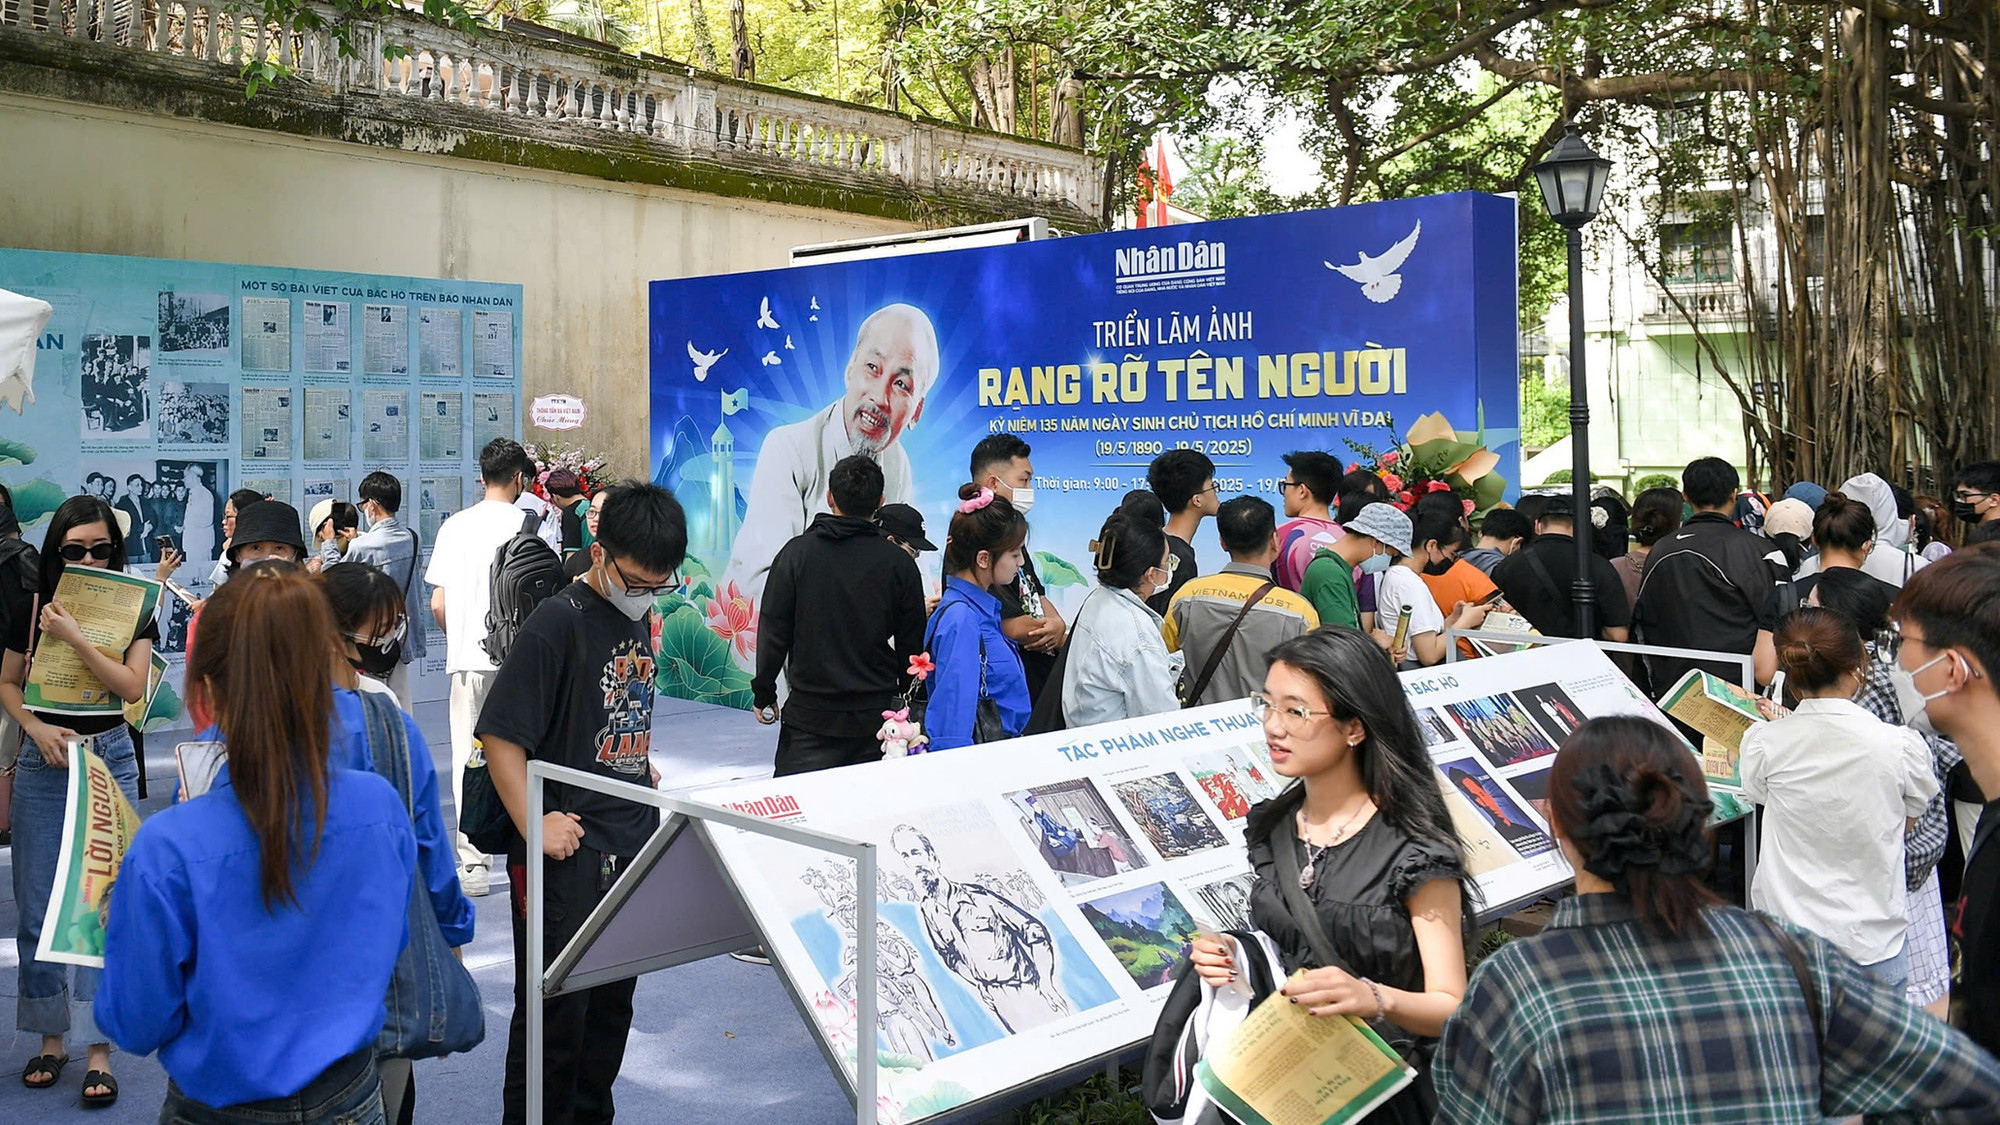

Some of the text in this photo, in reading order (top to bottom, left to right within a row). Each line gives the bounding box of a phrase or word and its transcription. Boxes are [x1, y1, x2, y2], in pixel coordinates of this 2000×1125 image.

[1115, 240, 1225, 277] Nhân Dân
[1093, 305, 1253, 348] TRIỂN LÃM ẢNH
[978, 341, 1407, 411] RẠNG RỠ TÊN NGƯỜI
[1008, 417, 1037, 434] NIỆM
[1040, 418, 1058, 432] 135
[1061, 416, 1089, 431] NĂM
[1092, 413, 1129, 431] NGÀY
[1132, 416, 1165, 431] SINH
[1168, 412, 1199, 430] CHỦ
[1203, 415, 1238, 432] TỊCH
[1241, 409, 1264, 429] HỒ
[1268, 408, 1296, 428] CHÍ
[1299, 411, 1339, 427] MINH
[1342, 409, 1360, 427] VĨ
[1095, 439, 1162, 457] (19/5/1890
[1175, 438, 1252, 456] 19/5/2025)
[1035, 476, 1060, 490] Thời
[1063, 478, 1091, 492] gian:
[1094, 477, 1119, 490] 9:00
[1131, 477, 1150, 490] 17:
[1192, 588, 1293, 609] VIETNAM OST
[88, 765, 113, 834] NGƯỜI
[721, 795, 800, 817] hân Dân
[84, 839, 113, 877] LỜI
